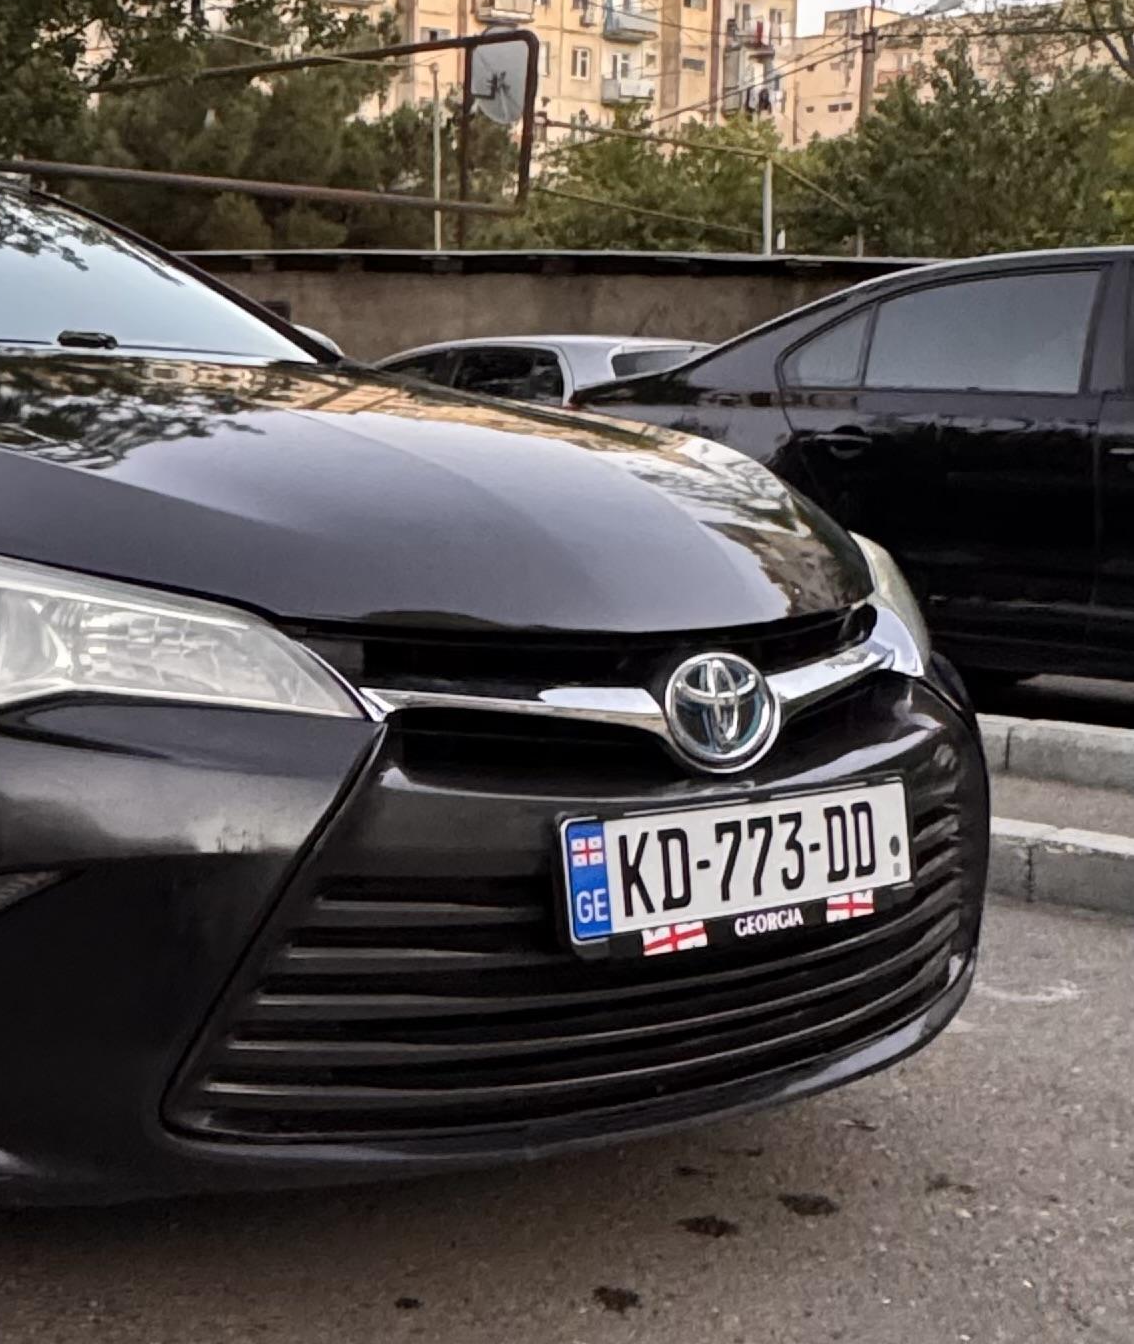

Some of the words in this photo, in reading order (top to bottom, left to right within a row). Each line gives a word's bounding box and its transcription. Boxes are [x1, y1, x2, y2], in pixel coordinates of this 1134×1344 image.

[618, 801, 877, 918] KD-773-DD
[577, 888, 609, 924] GE
[734, 907, 804, 937] GEORGIA
